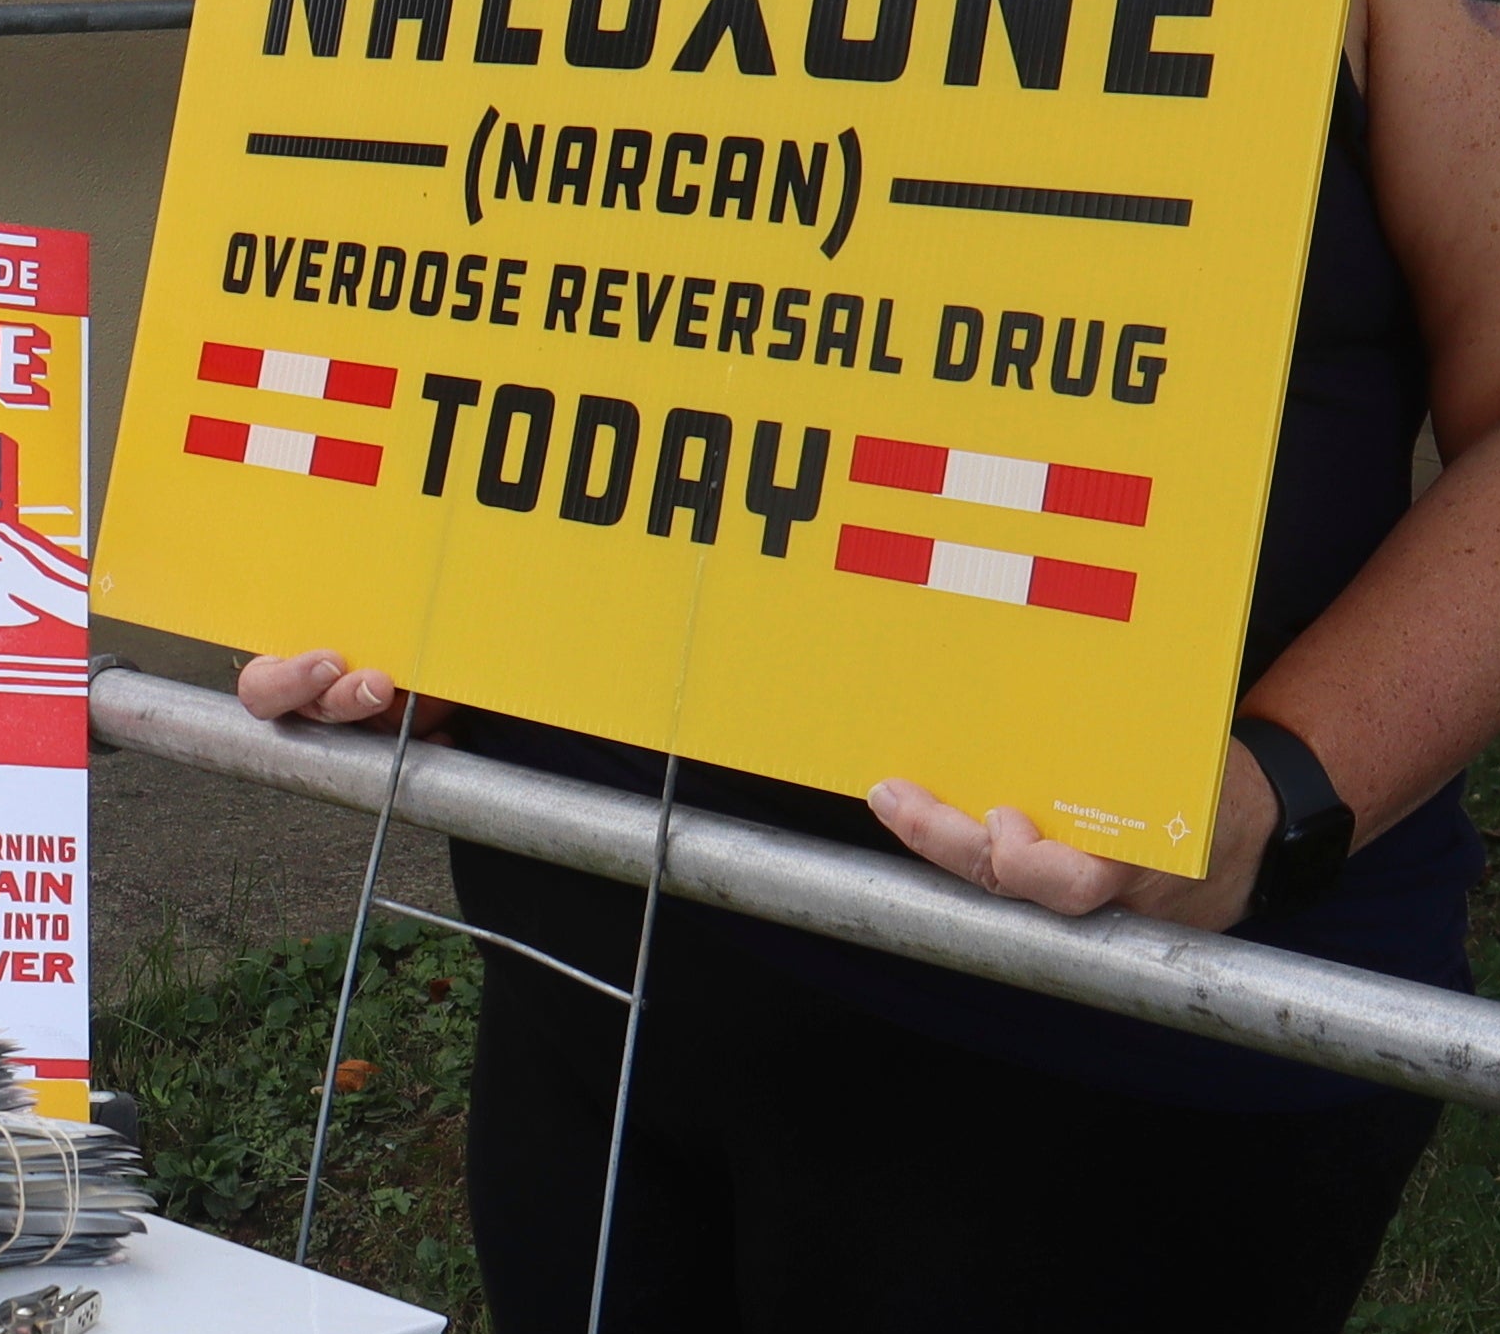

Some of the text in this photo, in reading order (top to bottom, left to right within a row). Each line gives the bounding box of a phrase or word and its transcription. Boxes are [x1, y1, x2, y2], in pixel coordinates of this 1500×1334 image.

[464, 107, 863, 258] (NARCAN)
[221, 232, 1168, 404] OVERDOSE REVERSAL DRUG
[417, 373, 830, 557] TODAY
[1053, 800, 1146, 830] RocketSigns.com
[3, 912, 70, 942] INTO
